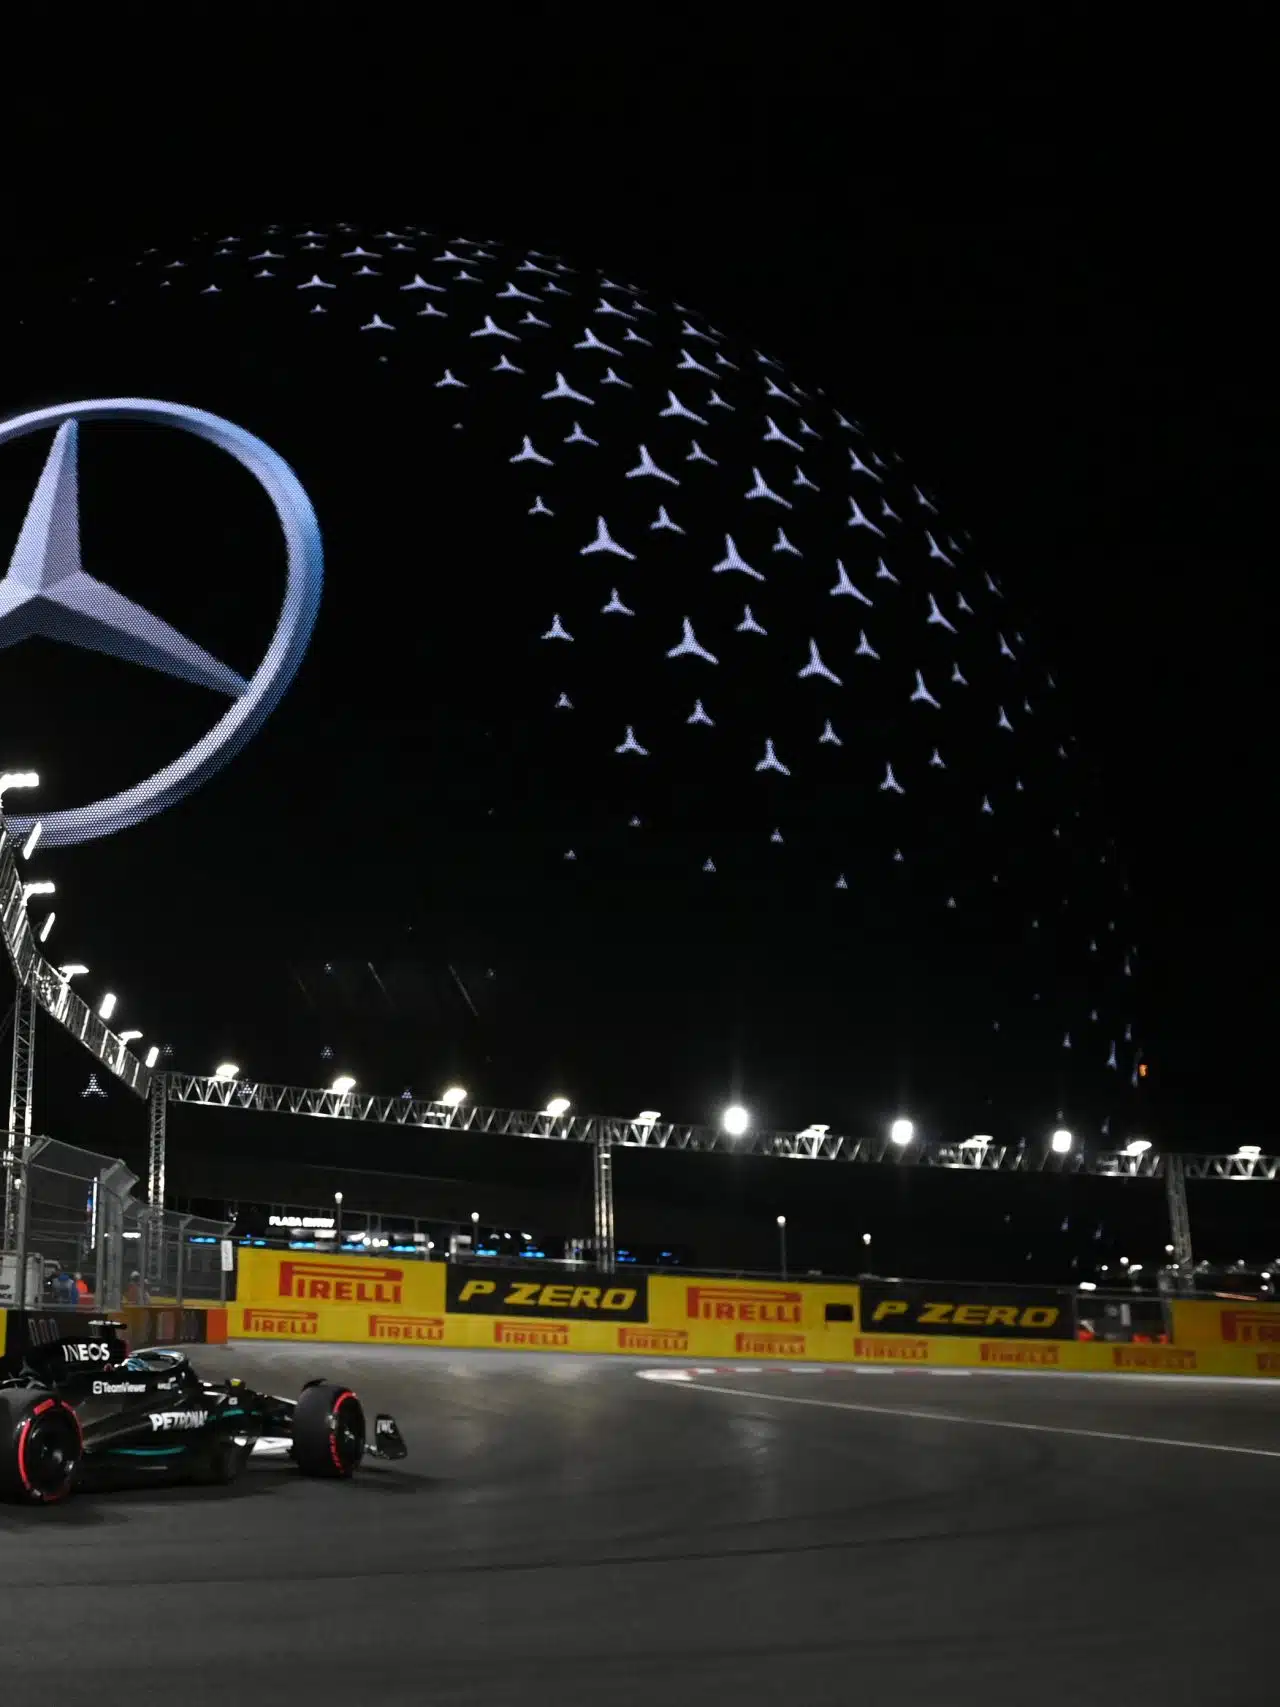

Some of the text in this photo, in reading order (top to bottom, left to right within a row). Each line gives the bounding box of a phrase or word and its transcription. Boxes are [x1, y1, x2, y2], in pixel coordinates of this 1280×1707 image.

[279, 1260, 404, 1304] PIRELLI
[458, 1279, 637, 1310] P ZERO
[686, 1286, 803, 1323] PIRELLI
[872, 1301, 1060, 1328] P ZERO
[243, 1308, 318, 1334] PIRELLI
[368, 1314, 445, 1340] PIRELLI
[494, 1321, 569, 1346] PIRELLI
[62, 1343, 111, 1362] INEOS
[618, 1328, 689, 1352] PIRELLI
[102, 1381, 147, 1393] TeamViewer
